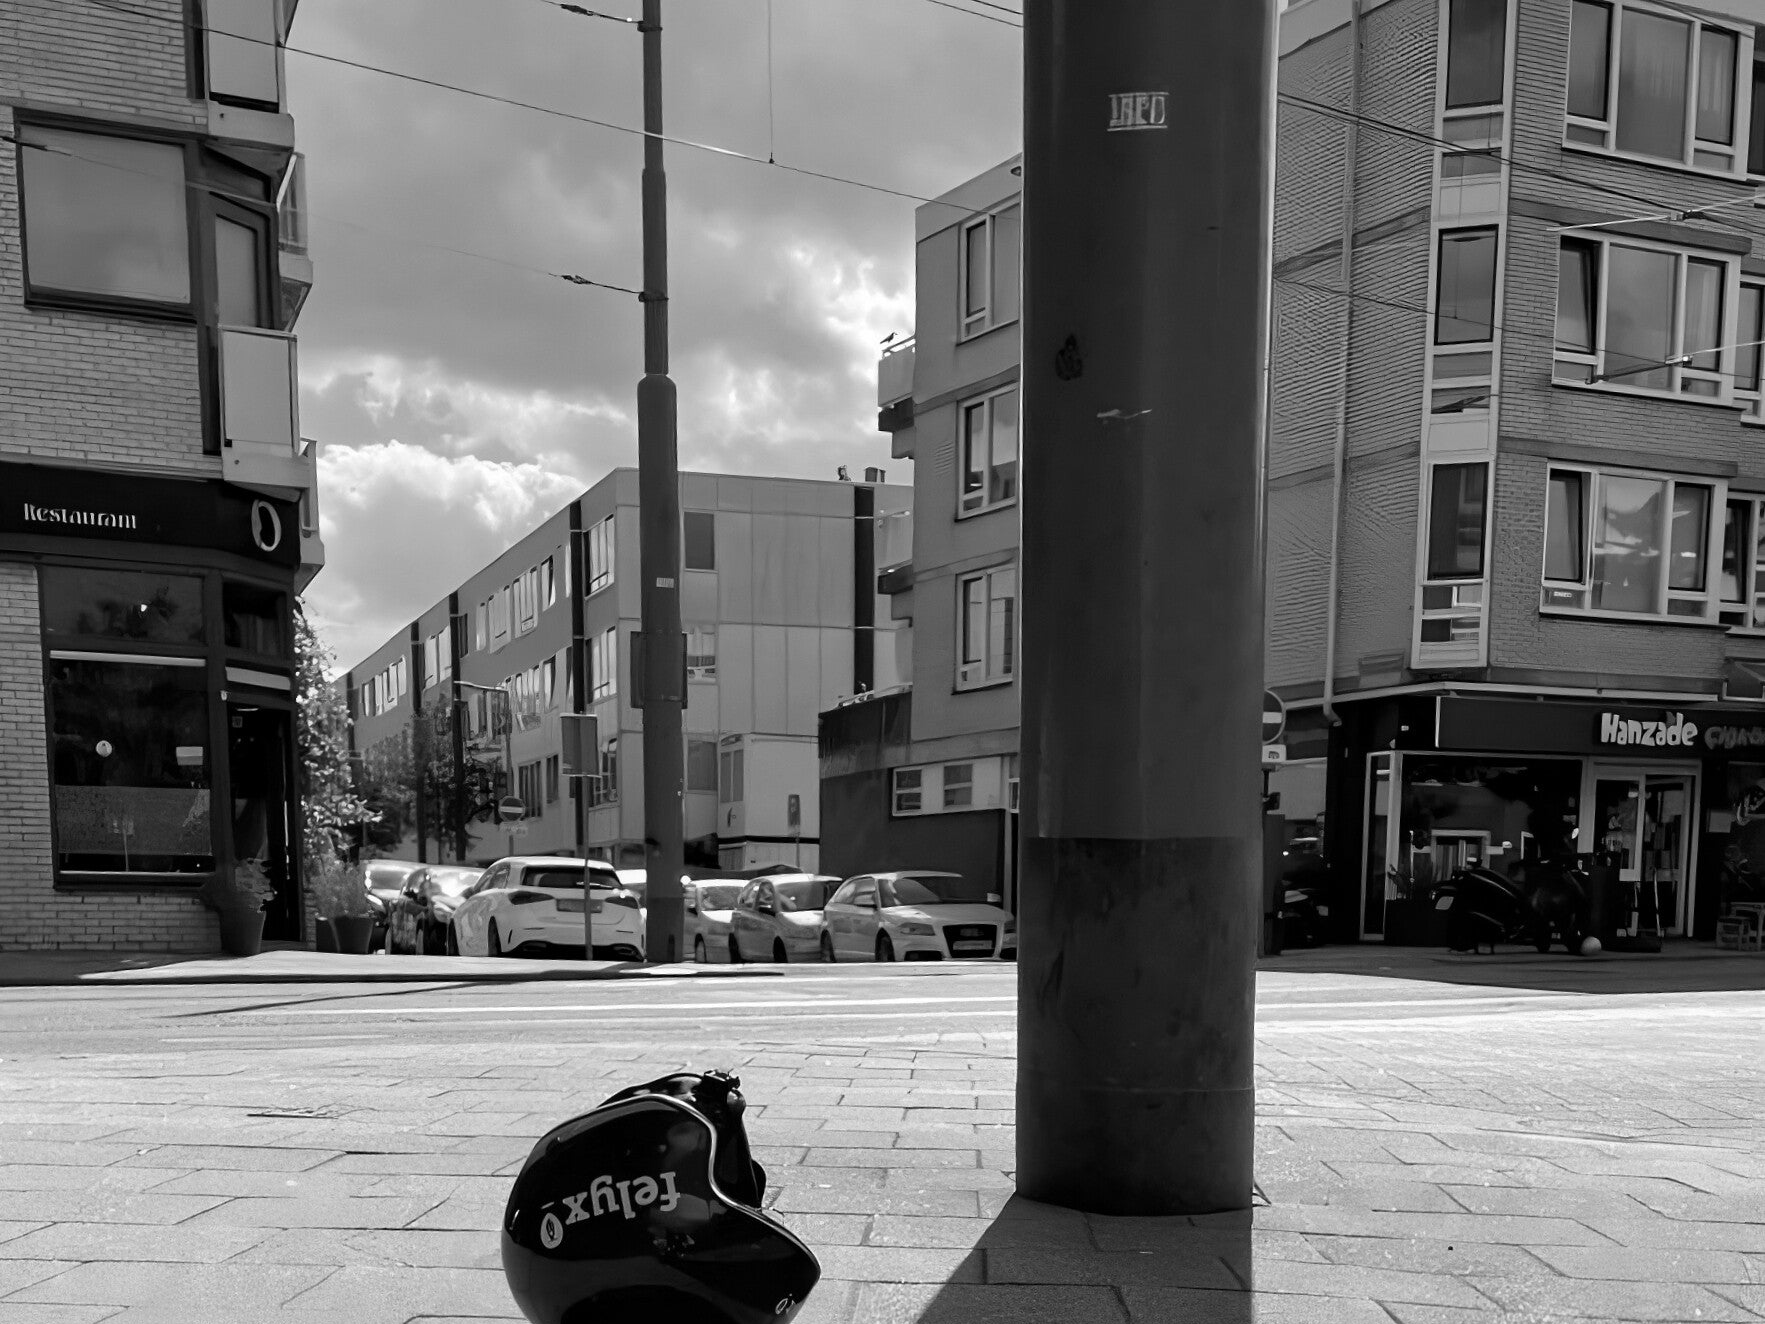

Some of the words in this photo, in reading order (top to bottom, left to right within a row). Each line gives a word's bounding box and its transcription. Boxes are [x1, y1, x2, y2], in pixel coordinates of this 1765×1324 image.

[24, 502, 137, 530] Restaurant
[1601, 711, 1698, 746] Hanzade
[562, 1171, 681, 1226] felyx
